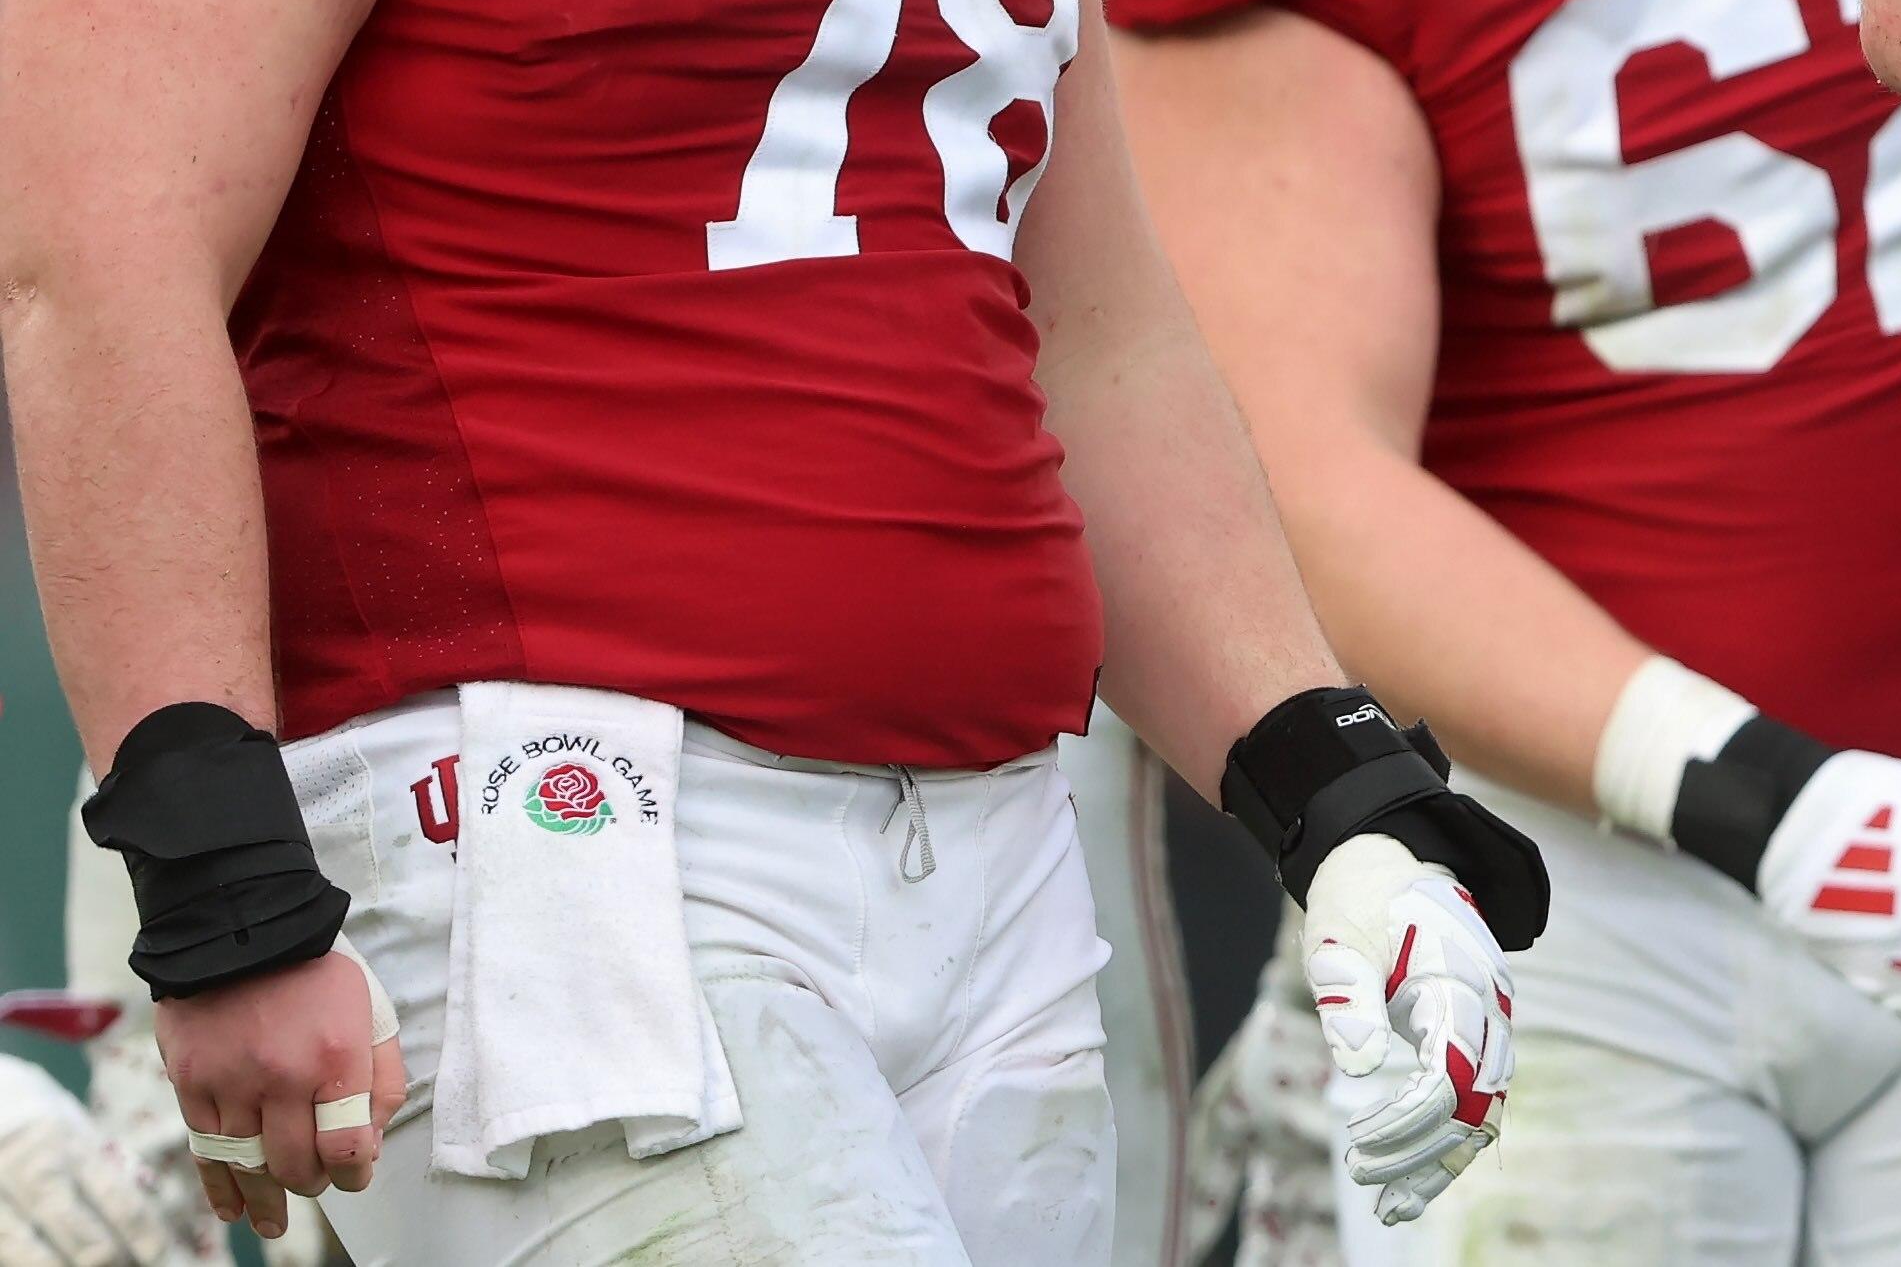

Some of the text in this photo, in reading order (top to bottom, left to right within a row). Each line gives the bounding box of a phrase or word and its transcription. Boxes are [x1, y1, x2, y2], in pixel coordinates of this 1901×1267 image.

[481, 733, 659, 826] ROSE BOWL GAME
